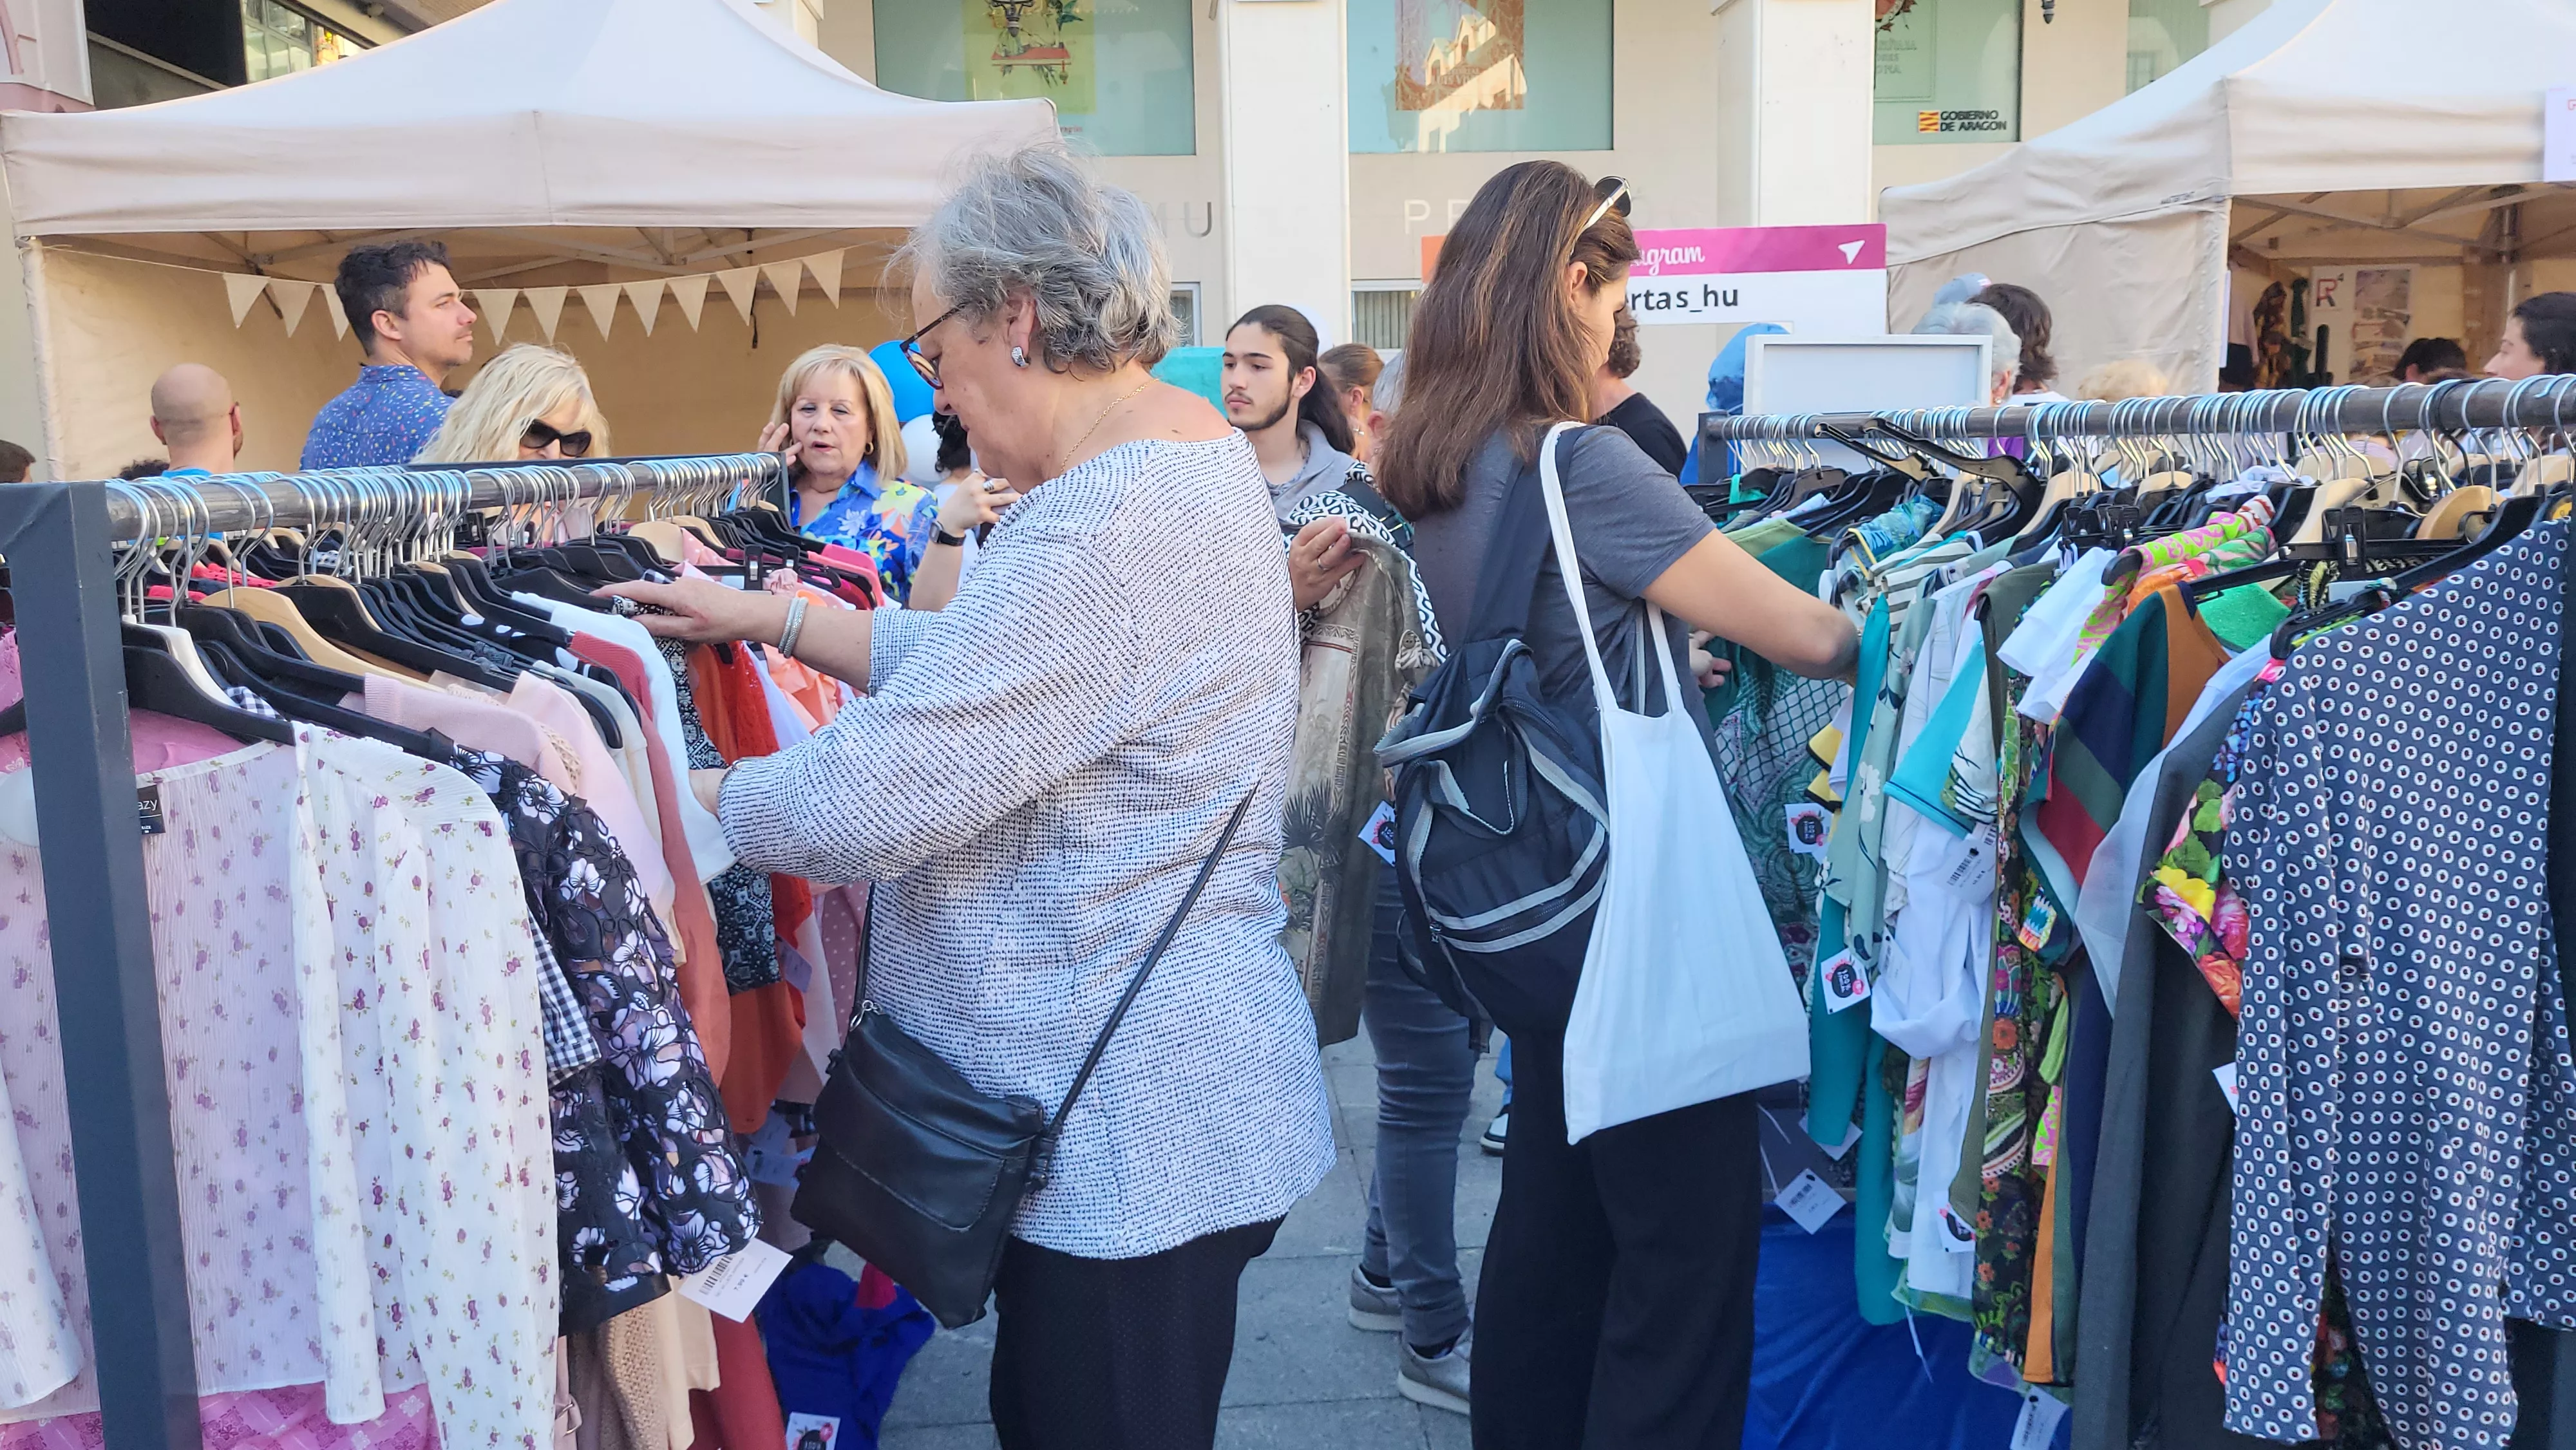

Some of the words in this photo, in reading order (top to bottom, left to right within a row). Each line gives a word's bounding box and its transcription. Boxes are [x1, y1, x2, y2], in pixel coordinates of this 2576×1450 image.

[1940, 110, 1999, 120] GOBIERNO
[1940, 122, 1955, 131] DE
[1627, 283, 1739, 313] rtas_hu
